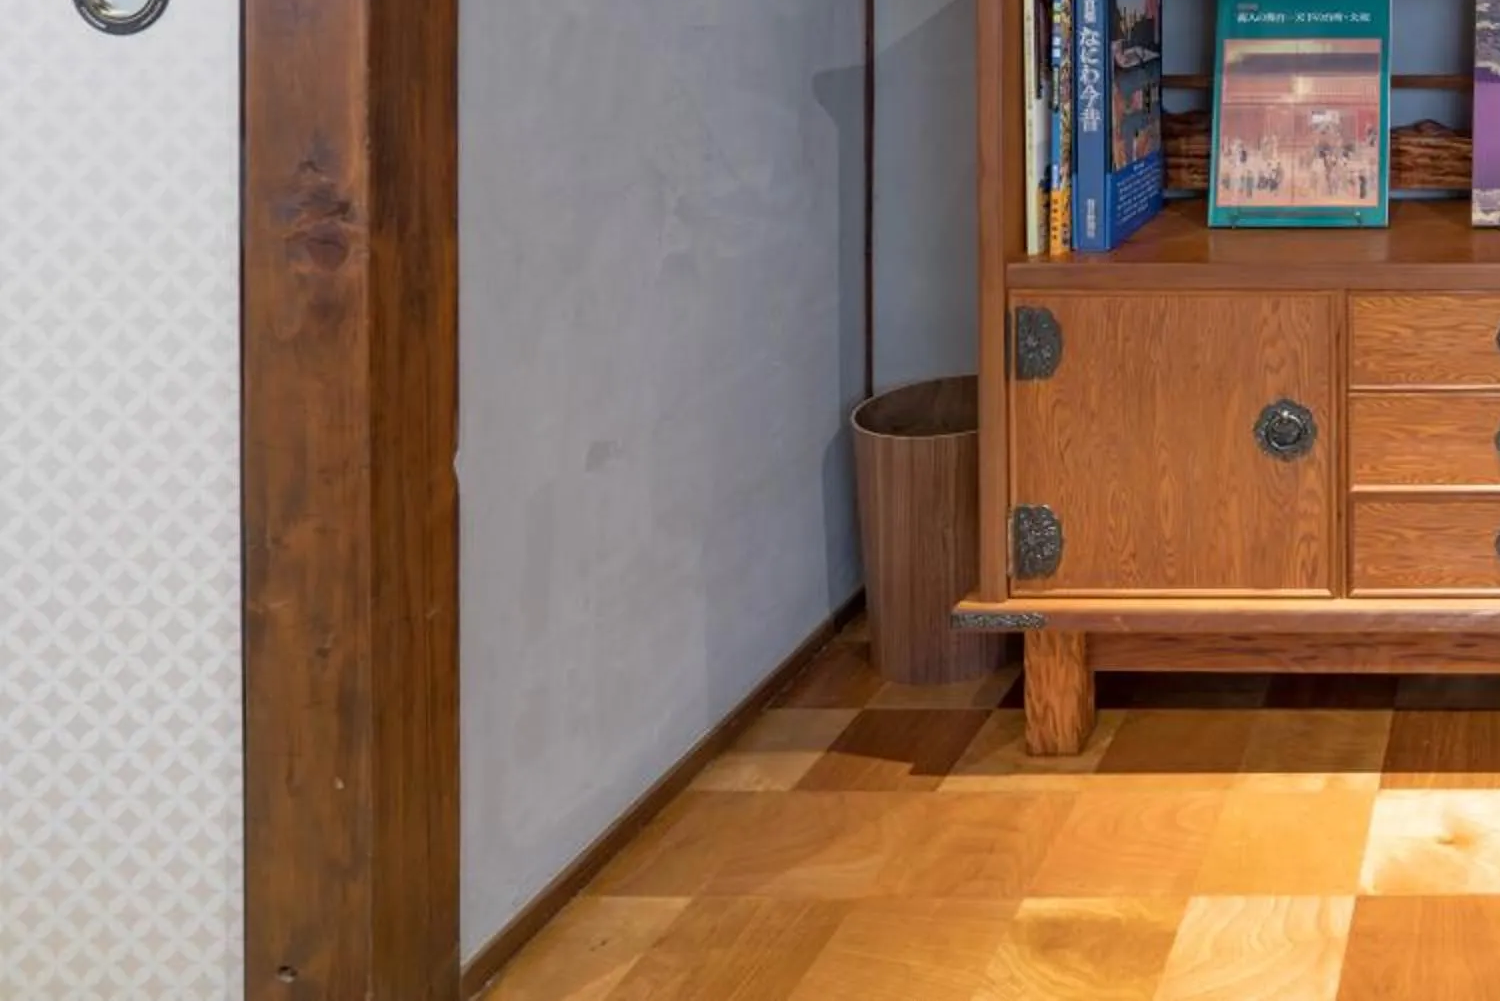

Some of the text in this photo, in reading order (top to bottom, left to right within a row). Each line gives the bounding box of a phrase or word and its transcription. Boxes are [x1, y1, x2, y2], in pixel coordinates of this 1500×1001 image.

[1078, 27, 1103, 132] なにわ今昔
